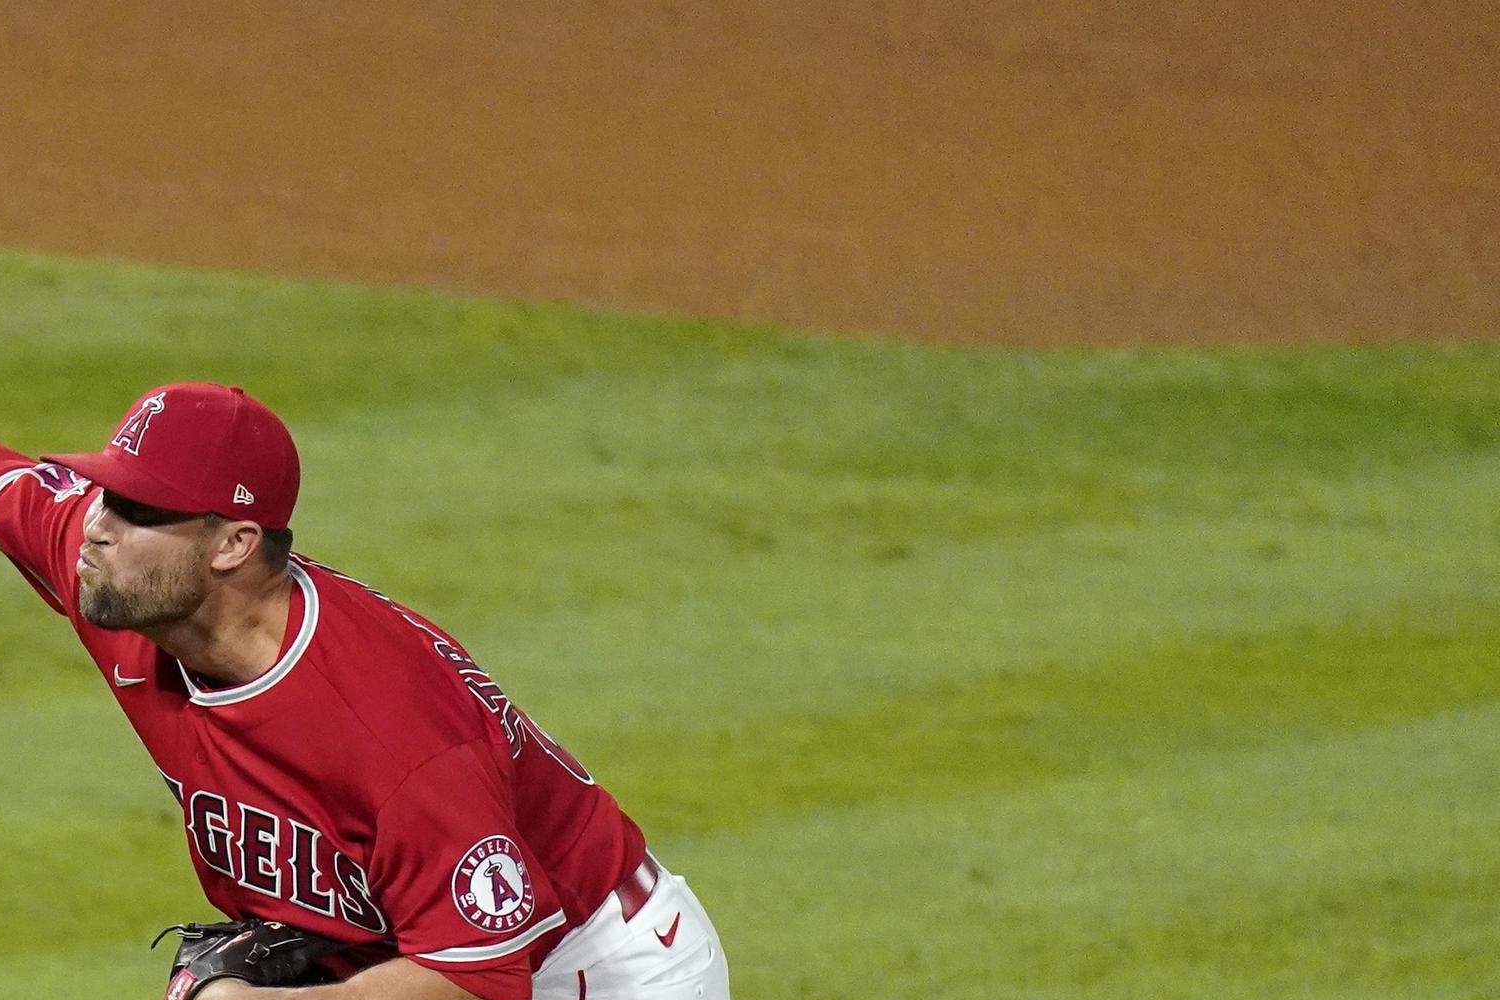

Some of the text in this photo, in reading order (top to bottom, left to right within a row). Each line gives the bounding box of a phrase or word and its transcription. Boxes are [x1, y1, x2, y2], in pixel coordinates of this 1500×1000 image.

[112, 392, 166, 456] A
[158, 767, 387, 934] GELS
[461, 839, 510, 877] ANGELS
[460, 892, 477, 908] 19
[484, 860, 520, 912] A
